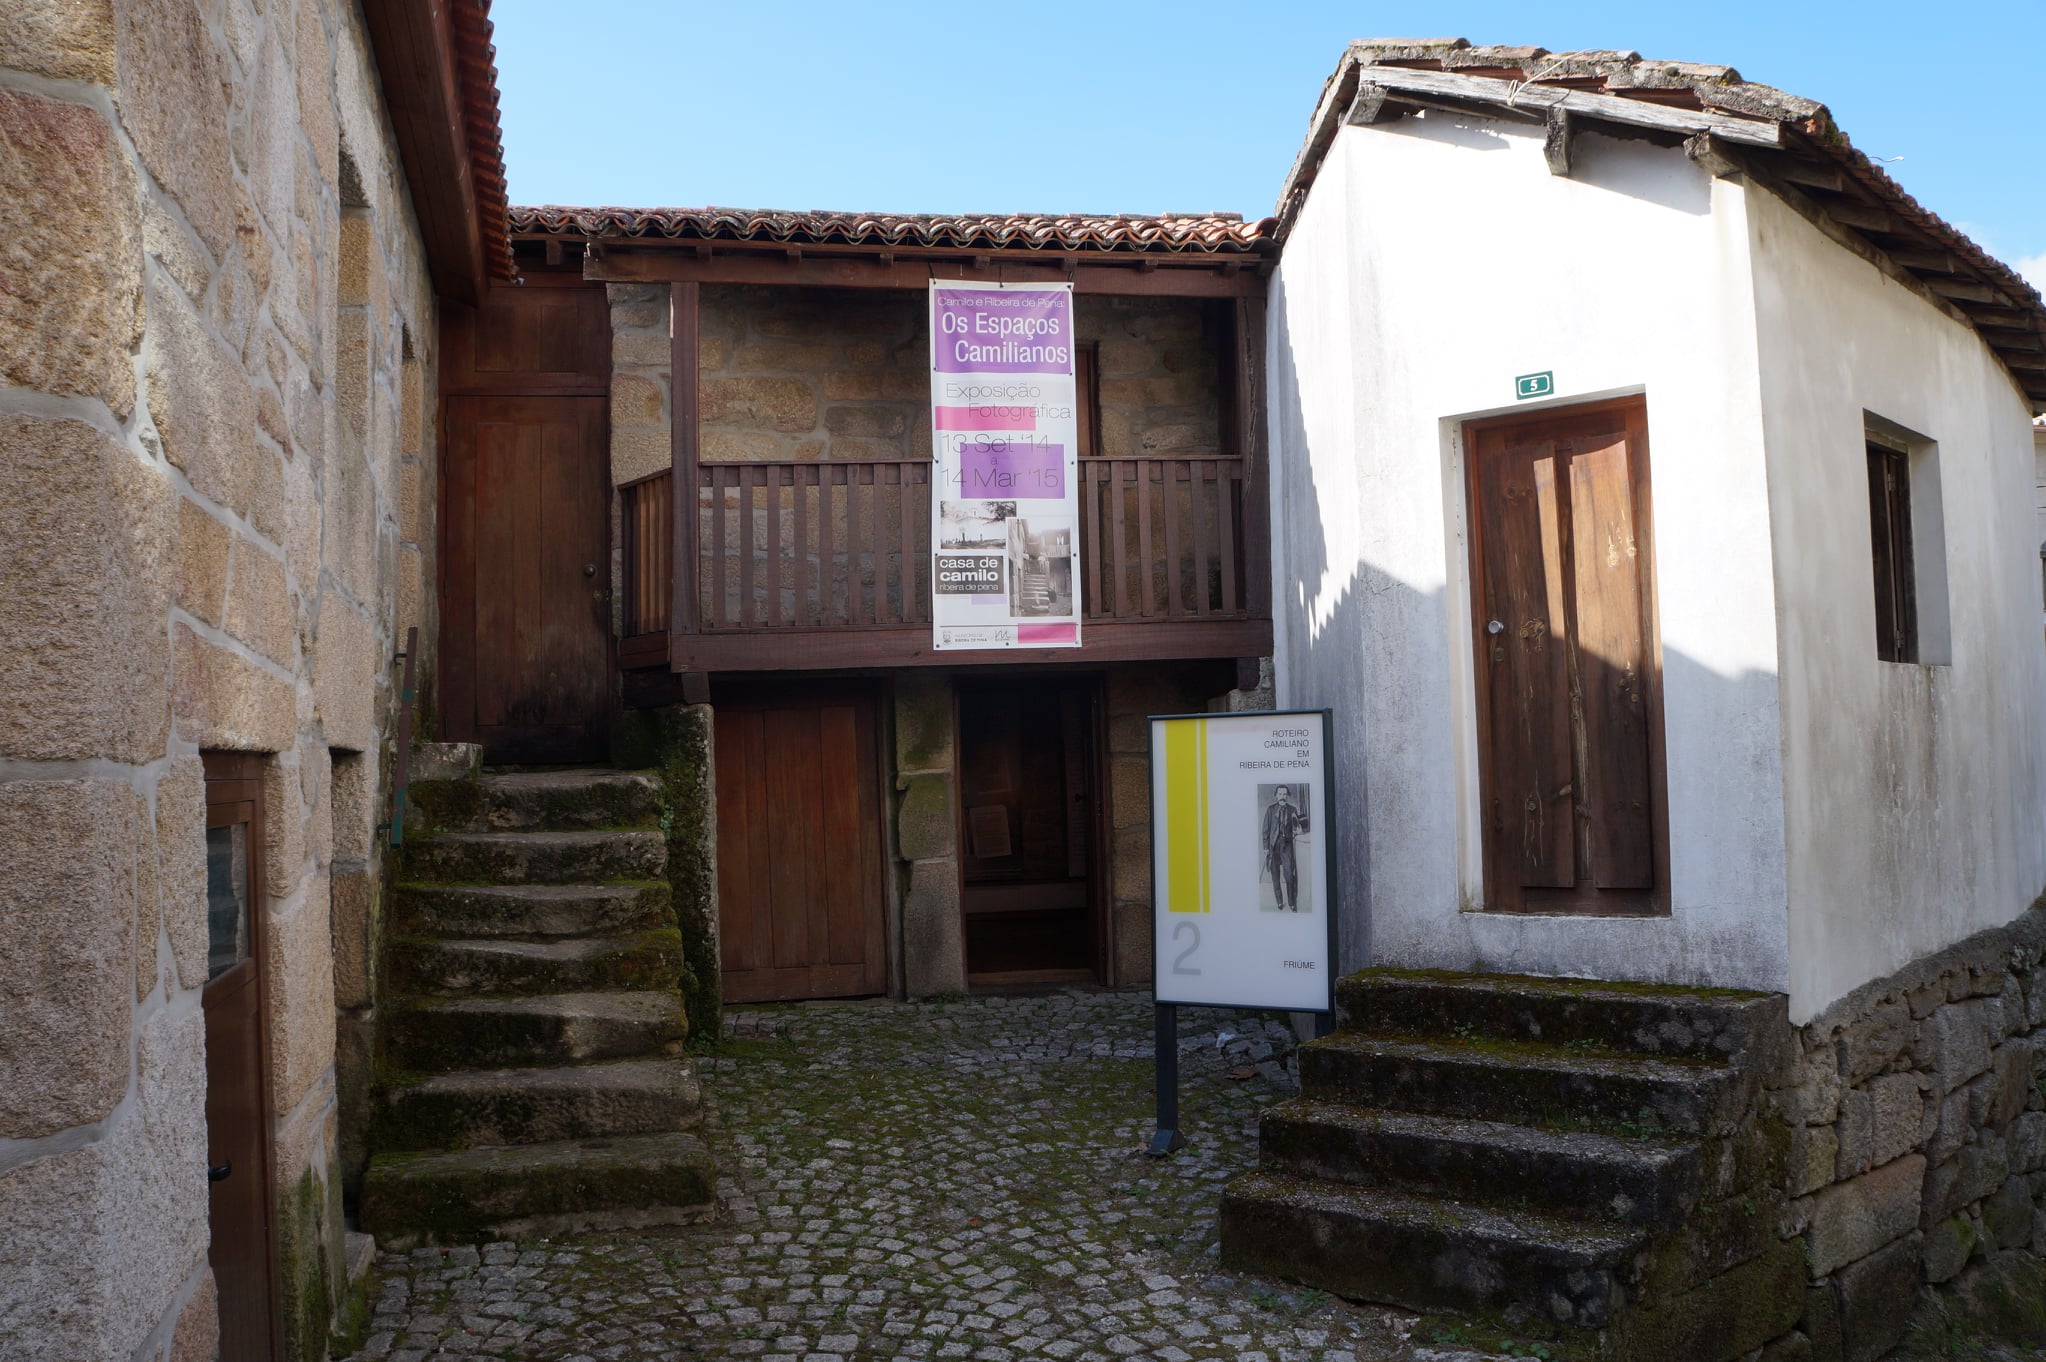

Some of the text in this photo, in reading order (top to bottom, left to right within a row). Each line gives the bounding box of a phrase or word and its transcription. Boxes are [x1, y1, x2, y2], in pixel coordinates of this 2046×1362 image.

[938, 296, 973, 307] Camilo
[976, 299, 982, 307] e
[985, 296, 1020, 307] Ribeira
[1022, 297, 1035, 307] de
[942, 312, 1060, 340] Os Espaços
[955, 340, 1068, 364] Camilianos
[1530, 379, 1538, 391] 5
[946, 383, 1041, 400] Exposição
[969, 402, 1071, 422] Fotográfica
[942, 434, 967, 453] 13
[975, 434, 1014, 453] Set
[990, 457, 997, 465] a
[942, 468, 967, 488] 14
[974, 468, 1022, 488] Mar
[939, 557, 998, 568] casa de
[940, 569, 998, 581] camilo
[939, 583, 998, 592] ribeira de pena
[1272, 729, 1309, 738] ROTEIRO
[1264, 739, 1309, 748] CAMILIANO
[1239, 761, 1271, 769] RIBEIRA
[1287, 760, 1310, 768] PENA
[1172, 920, 1201, 976] 2
